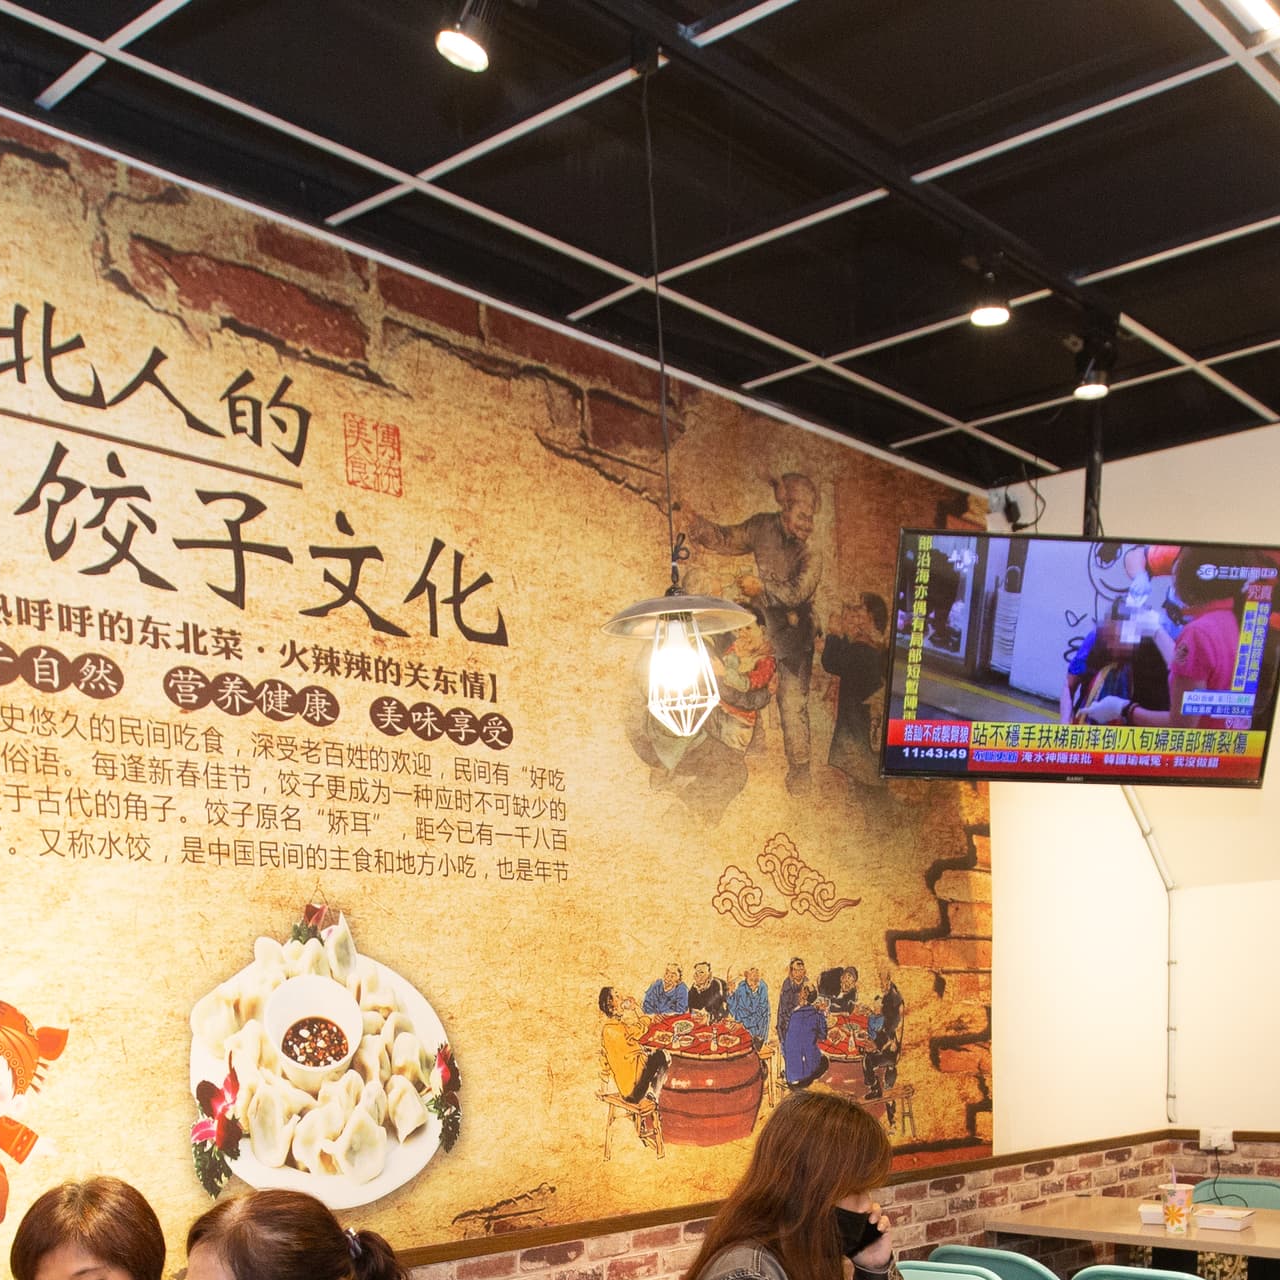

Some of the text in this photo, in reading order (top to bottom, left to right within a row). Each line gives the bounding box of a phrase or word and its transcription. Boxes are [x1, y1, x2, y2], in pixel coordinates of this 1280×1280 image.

[14, 441, 510, 647] 饺子文化
[167, 669, 337, 724] 营养健康
[375, 700, 510, 747] 美味享受
[903, 746, 967, 759] 11:43:49
